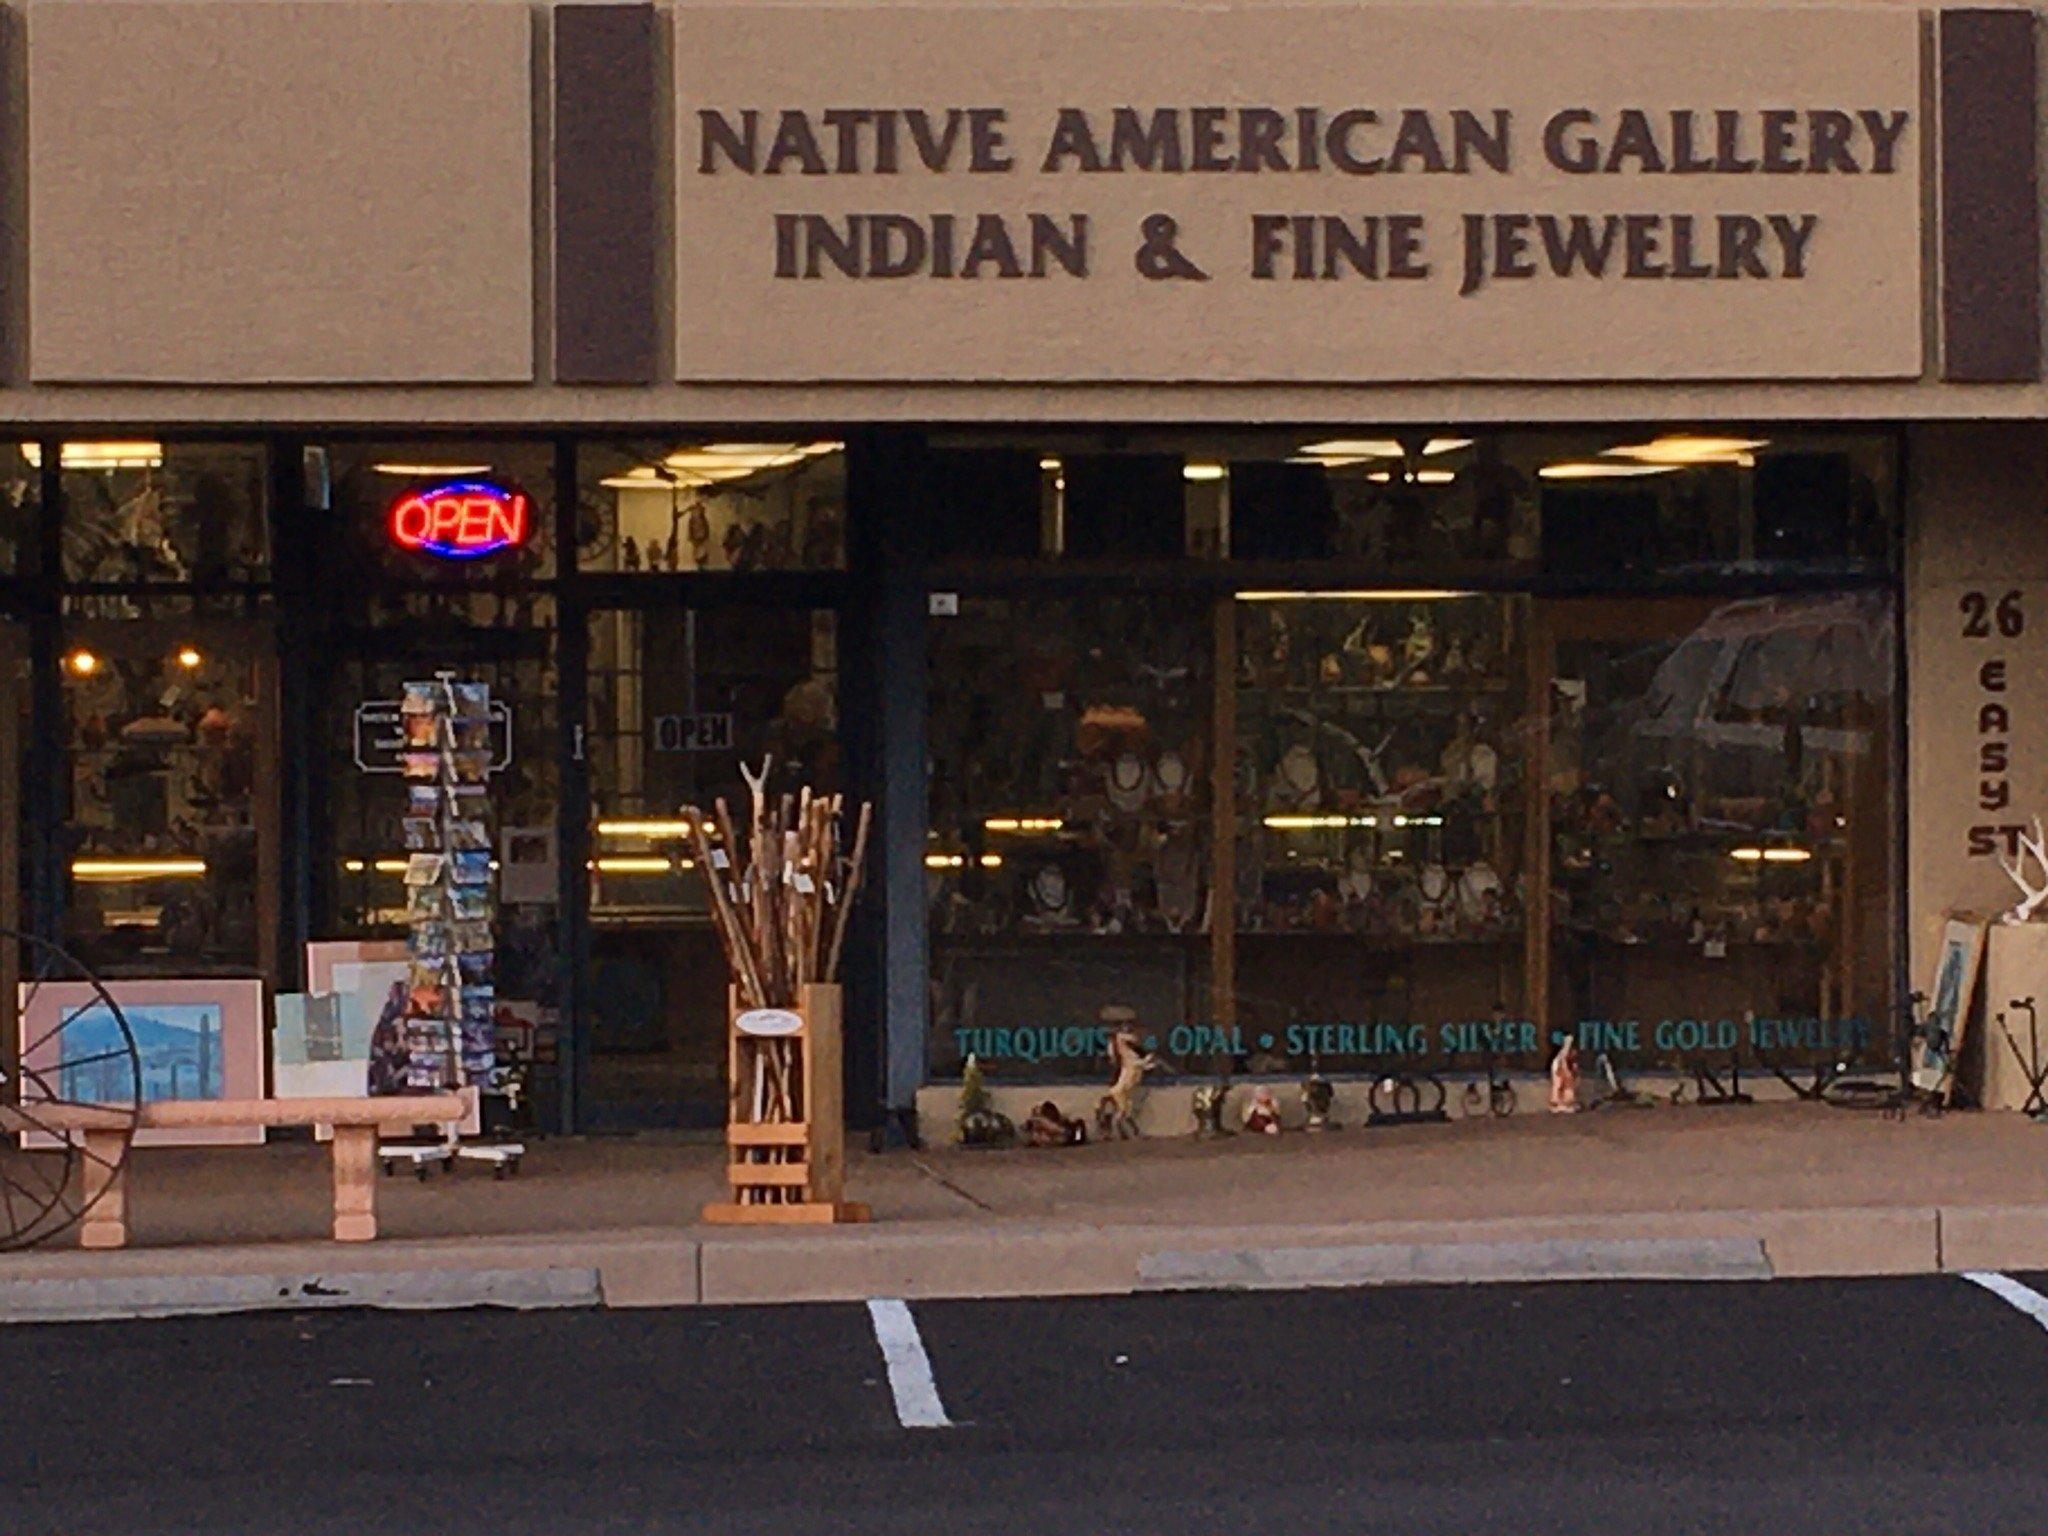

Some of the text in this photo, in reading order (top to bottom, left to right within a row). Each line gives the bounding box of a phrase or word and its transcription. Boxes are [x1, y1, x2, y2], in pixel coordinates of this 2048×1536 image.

[698, 108, 1909, 174] NATIVE AMERICAN GALLERY
[774, 213, 1818, 296] INDIAN & FINE JEWELRY
[394, 493, 527, 548] OPEN
[1959, 590, 2024, 638] 26
[661, 716, 728, 747] OPEN
[1967, 825, 2028, 857] ST
[954, 1025, 1114, 1062] TURQUOIS
[1169, 1024, 1247, 1055] OPAL
[1286, 1022, 1428, 1055] STERLING
[1440, 1020, 1538, 1054] SILVER
[1577, 1019, 1641, 1051] FINE
[1655, 1018, 1738, 1051] GOLD
